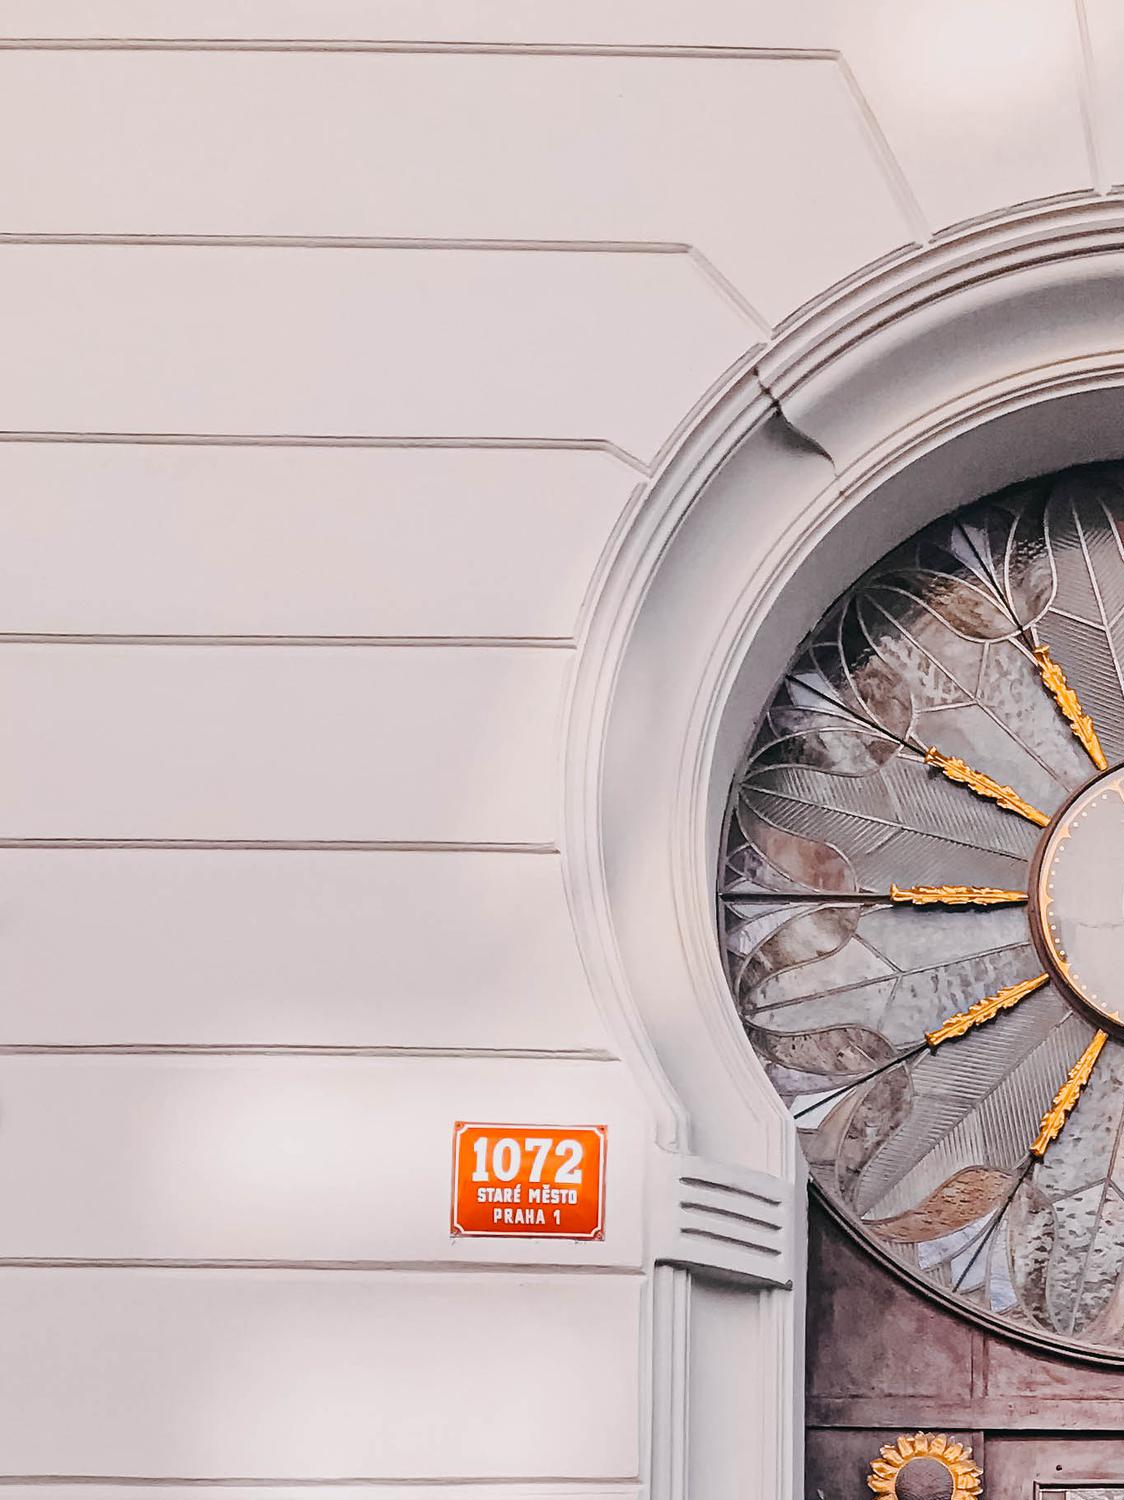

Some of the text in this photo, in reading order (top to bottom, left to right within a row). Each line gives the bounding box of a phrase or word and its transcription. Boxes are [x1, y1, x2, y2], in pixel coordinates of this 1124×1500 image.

[472, 1137, 584, 1184] 1072
[477, 1184, 578, 1204] STARÉ MĚSTO
[493, 1208, 561, 1225] PRAHA 1
